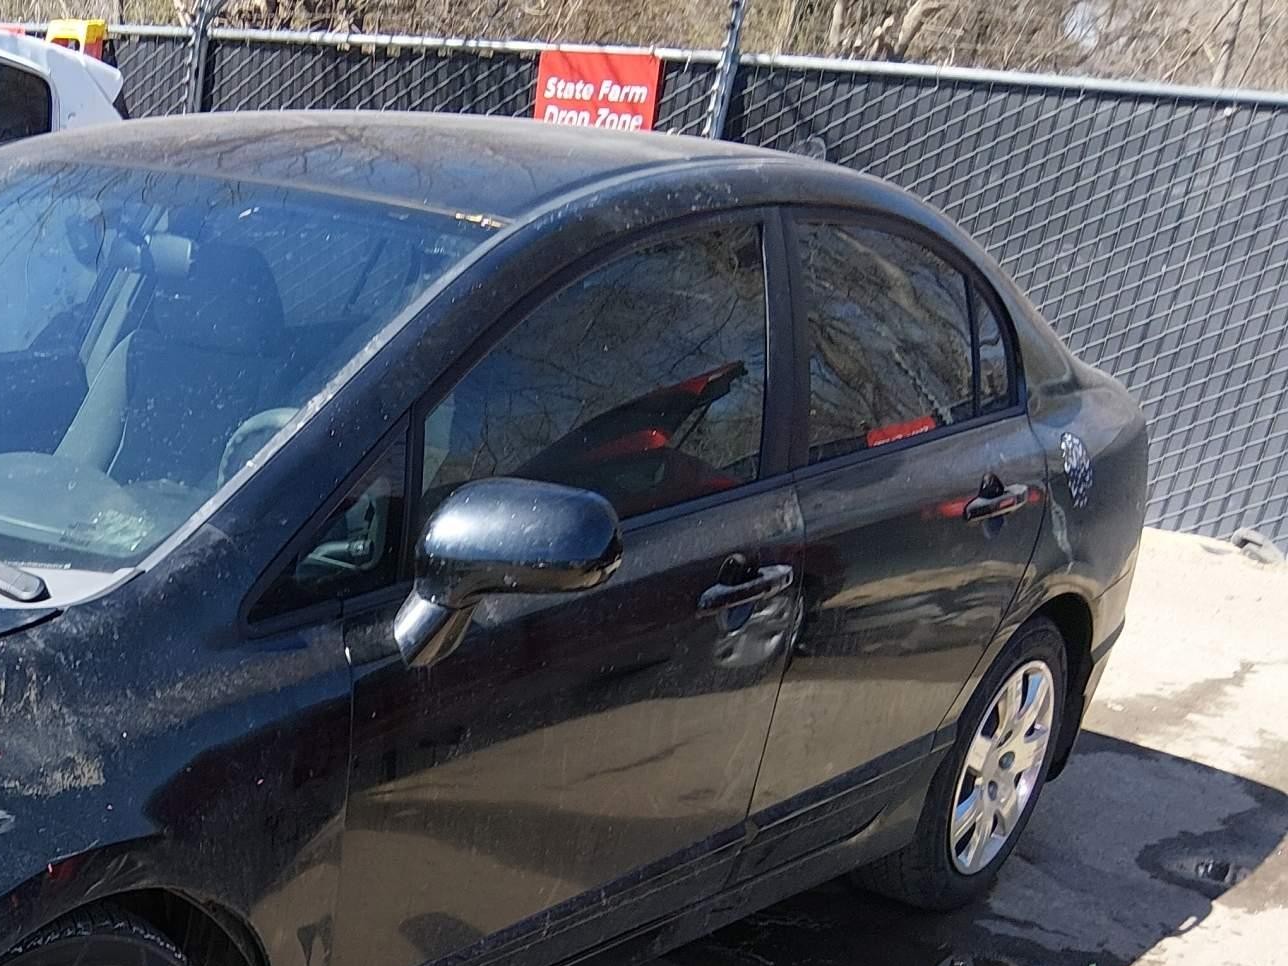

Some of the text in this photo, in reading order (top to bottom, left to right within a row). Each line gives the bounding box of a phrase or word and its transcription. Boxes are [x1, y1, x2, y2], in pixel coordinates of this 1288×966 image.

[544, 77, 648, 104] State Farm
[594, 108, 643, 132] Zone
